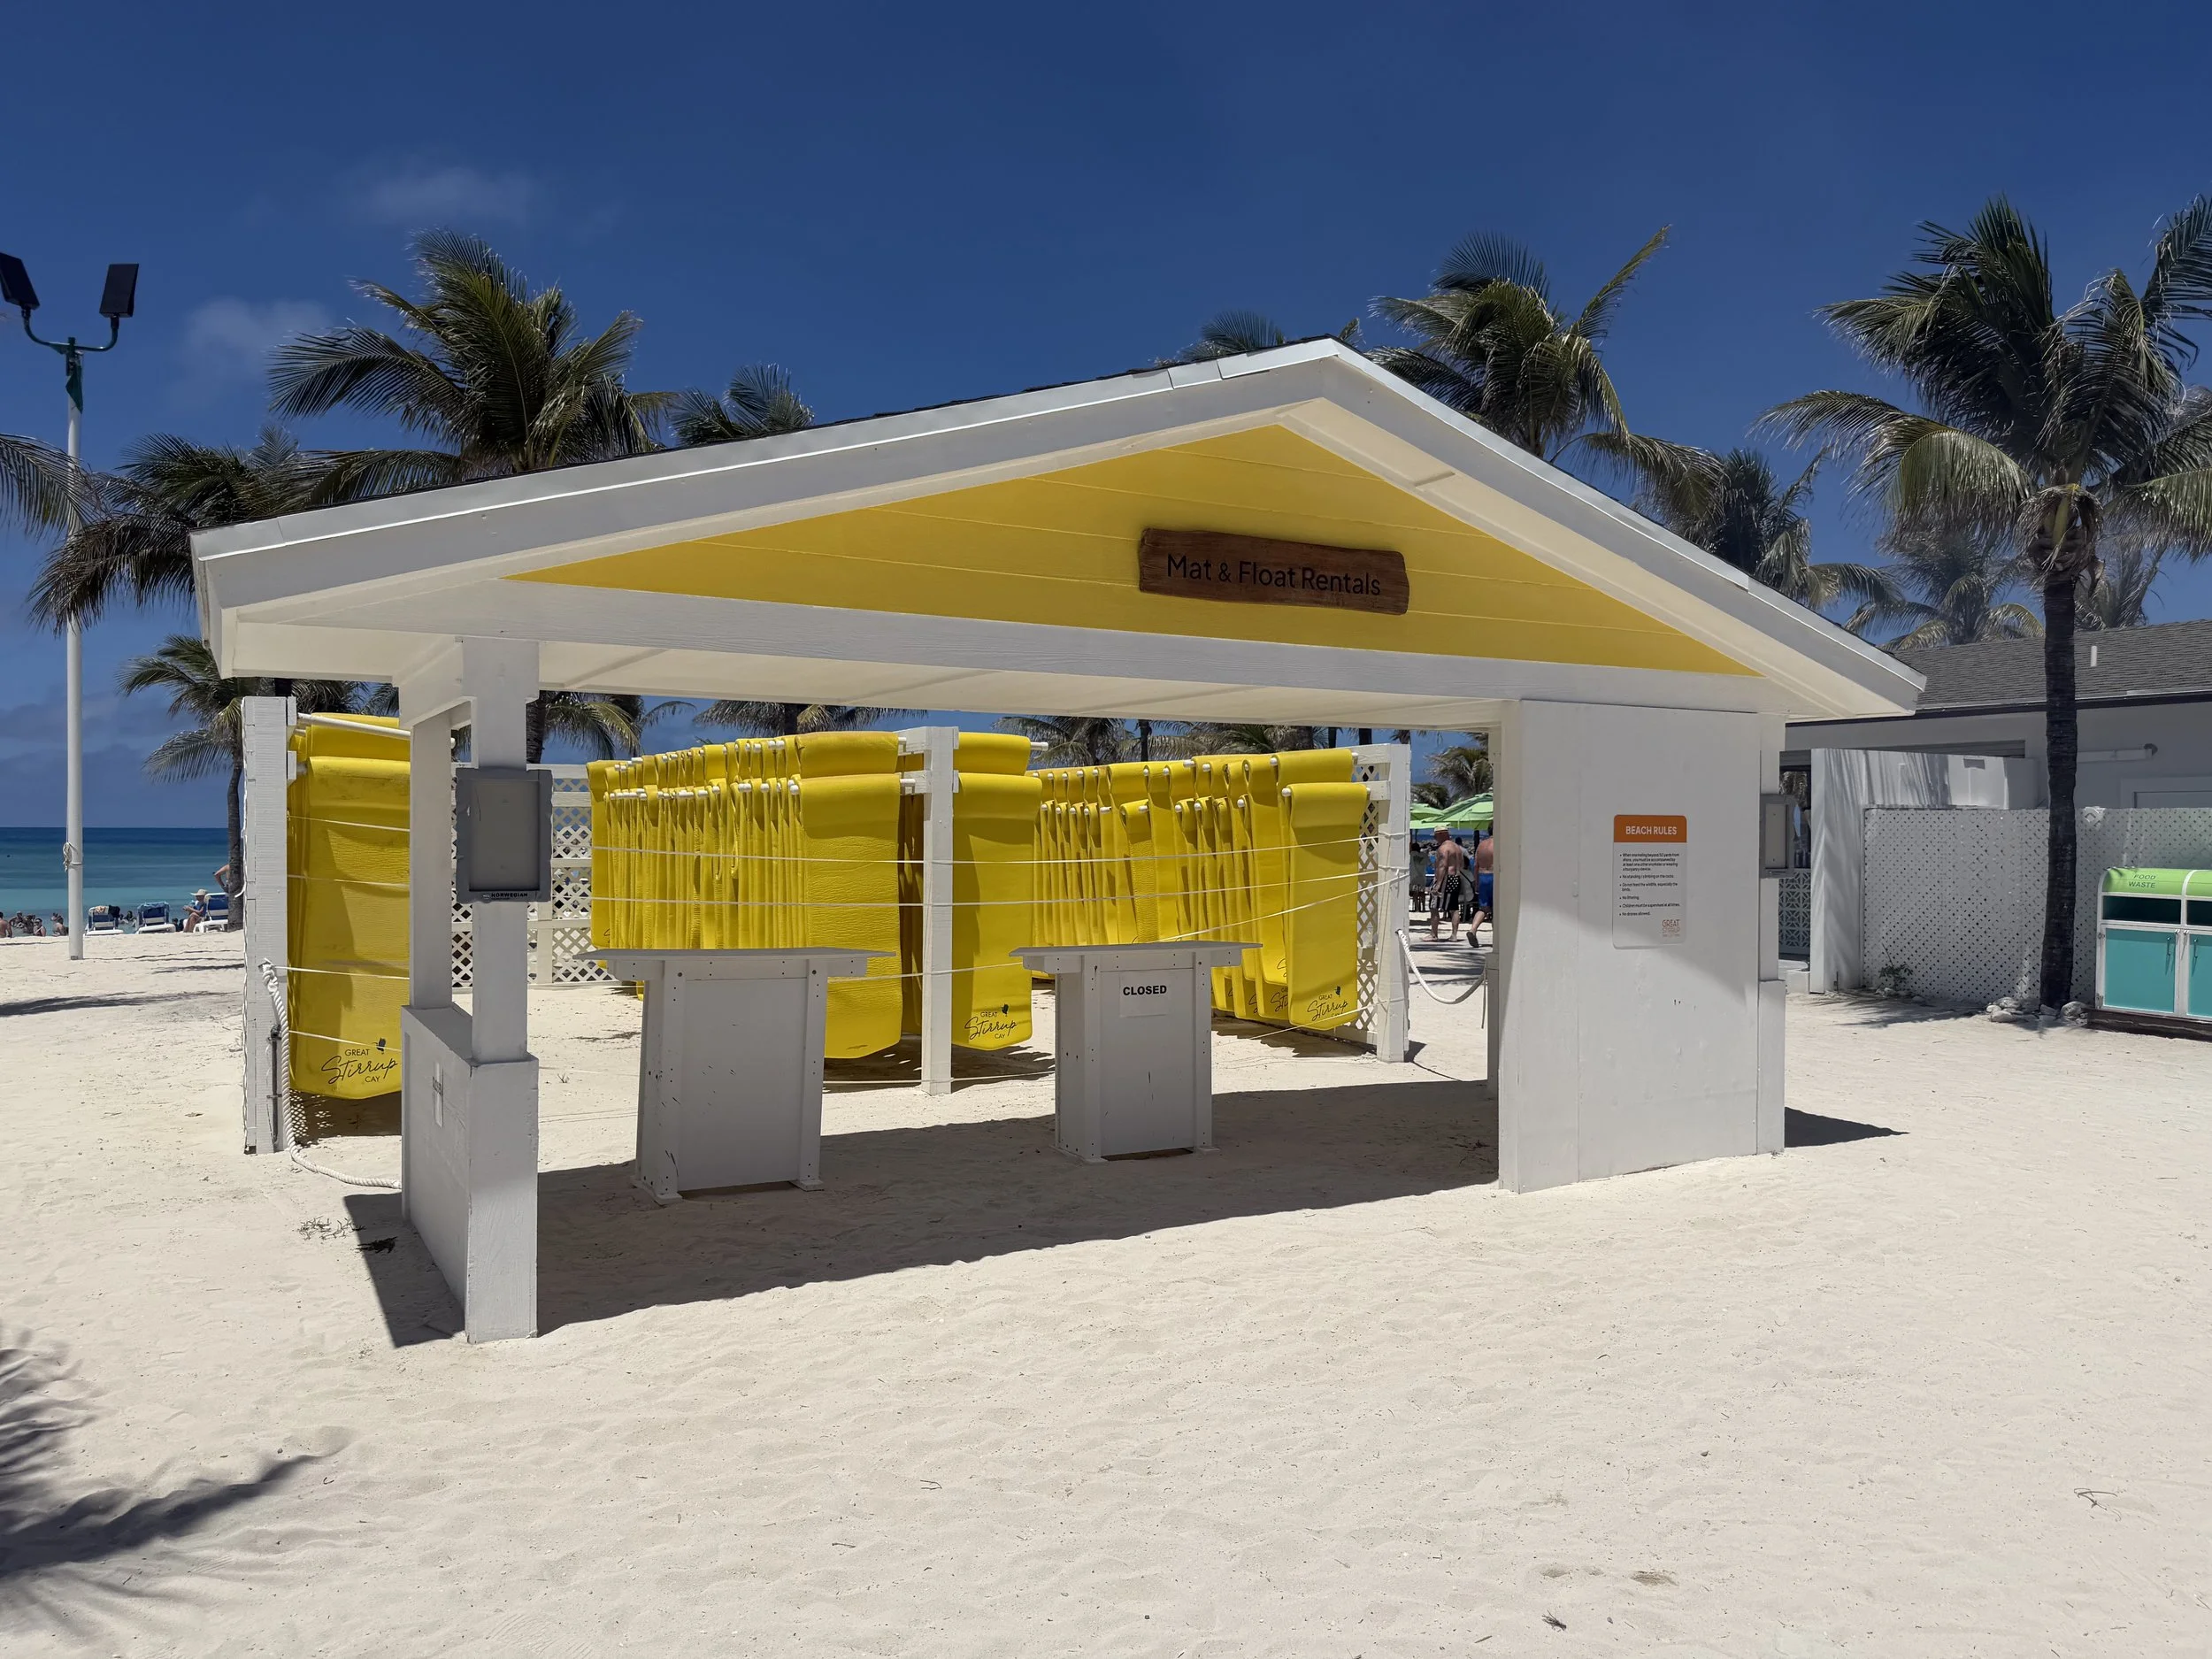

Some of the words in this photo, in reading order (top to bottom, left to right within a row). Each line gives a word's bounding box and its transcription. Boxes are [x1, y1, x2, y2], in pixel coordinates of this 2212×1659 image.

[1168, 553, 1211, 581] Mat
[1218, 562, 1231, 583] &
[1239, 560, 1297, 587] Float
[1302, 566, 1381, 596] Rentals
[1625, 826, 1652, 835] BEACH
[1653, 826, 1678, 835] RULES
[1123, 985, 1167, 995] CLOSED
[964, 1016, 1017, 1040] Stirrup
[321, 1055, 398, 1084] Stirrup
